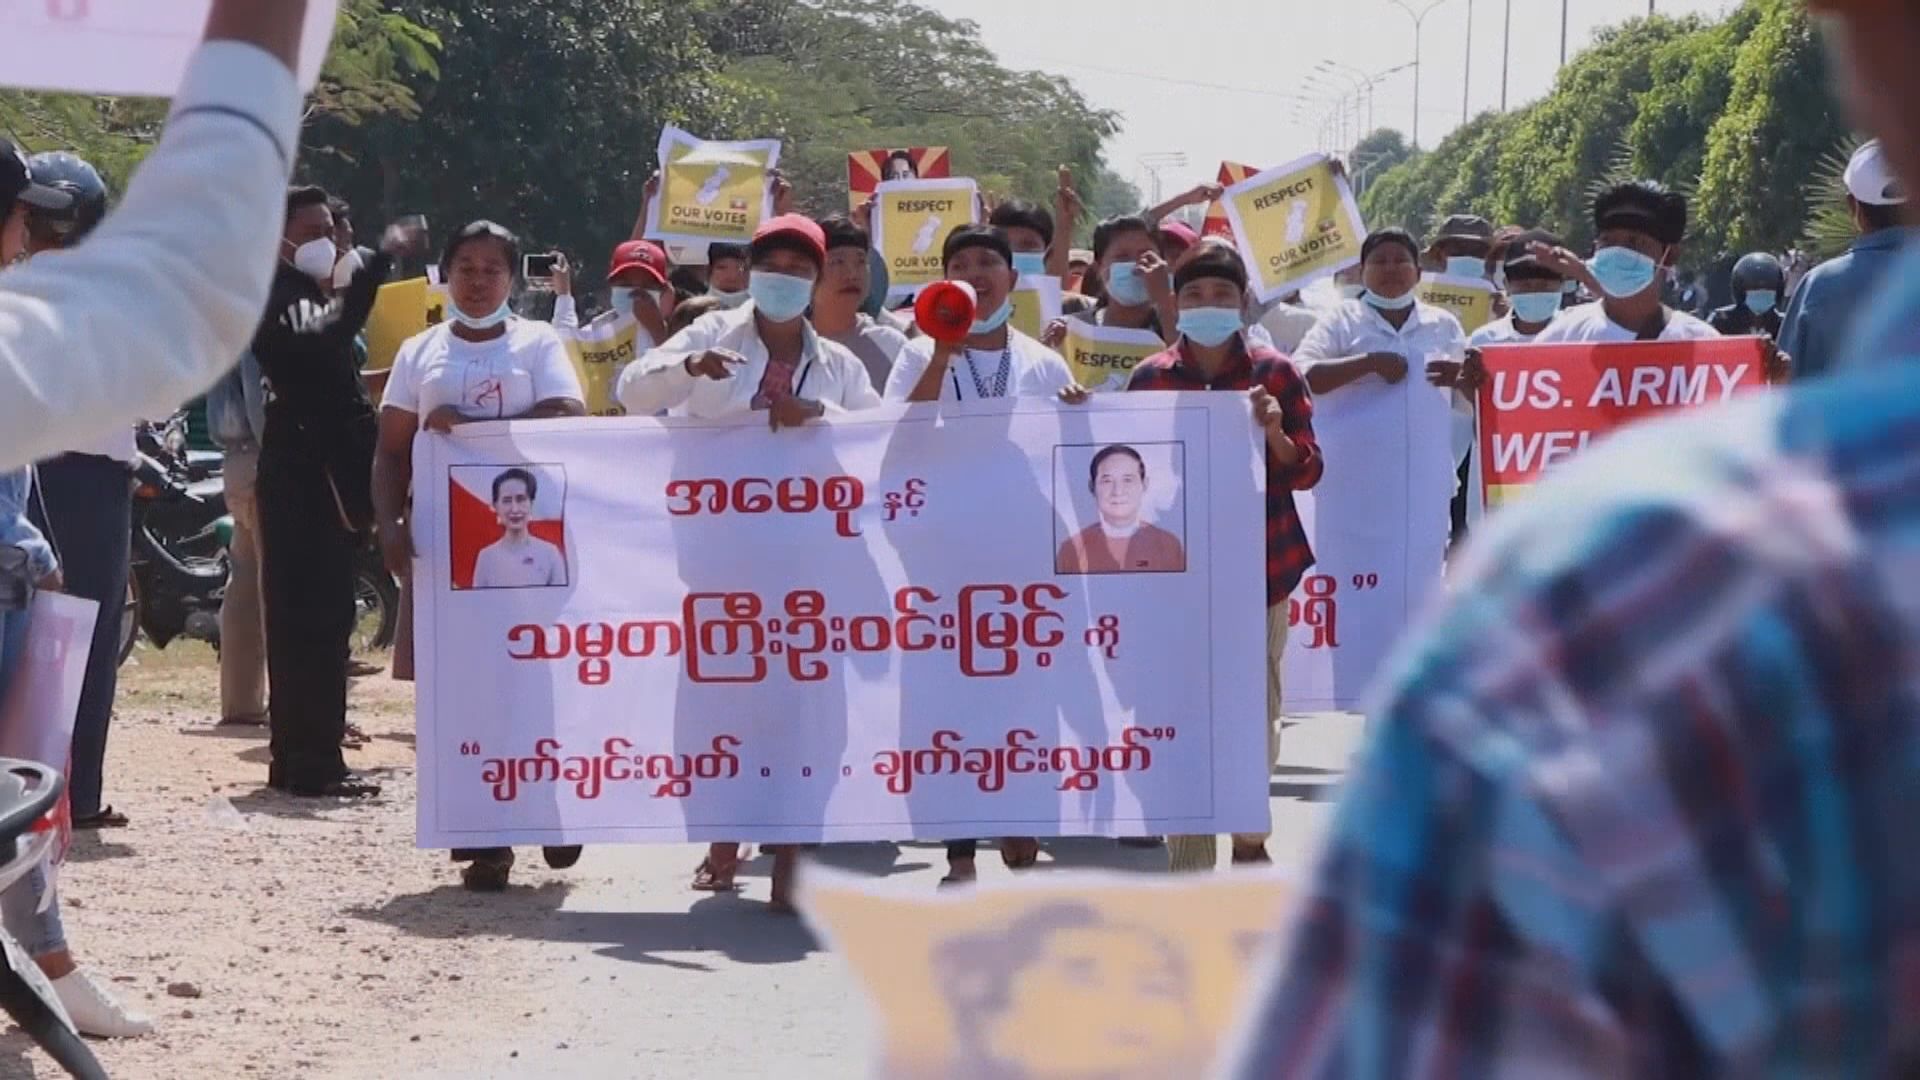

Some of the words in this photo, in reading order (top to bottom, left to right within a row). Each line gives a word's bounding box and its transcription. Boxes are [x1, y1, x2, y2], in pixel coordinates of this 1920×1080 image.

[897, 200, 954, 213] RESPECT
[1253, 178, 1315, 210] RESPECT
[671, 205, 701, 218] OUR
[704, 208, 747, 224] VOTES
[895, 257, 919, 268] OUR
[1269, 247, 1299, 268] OUR
[1297, 230, 1343, 256] VOTES
[1422, 291, 1474, 307] RESPECT
[1491, 369, 1573, 411] US.
[1586, 363, 1749, 408] ARMY
[665, 475, 864, 537] အမေစု
[882, 478, 926, 521] နှင့်
[507, 583, 1069, 686] သမ္မတကြီးဦးဝင်းမြင့်
[1084, 614, 1120, 659] ကို
